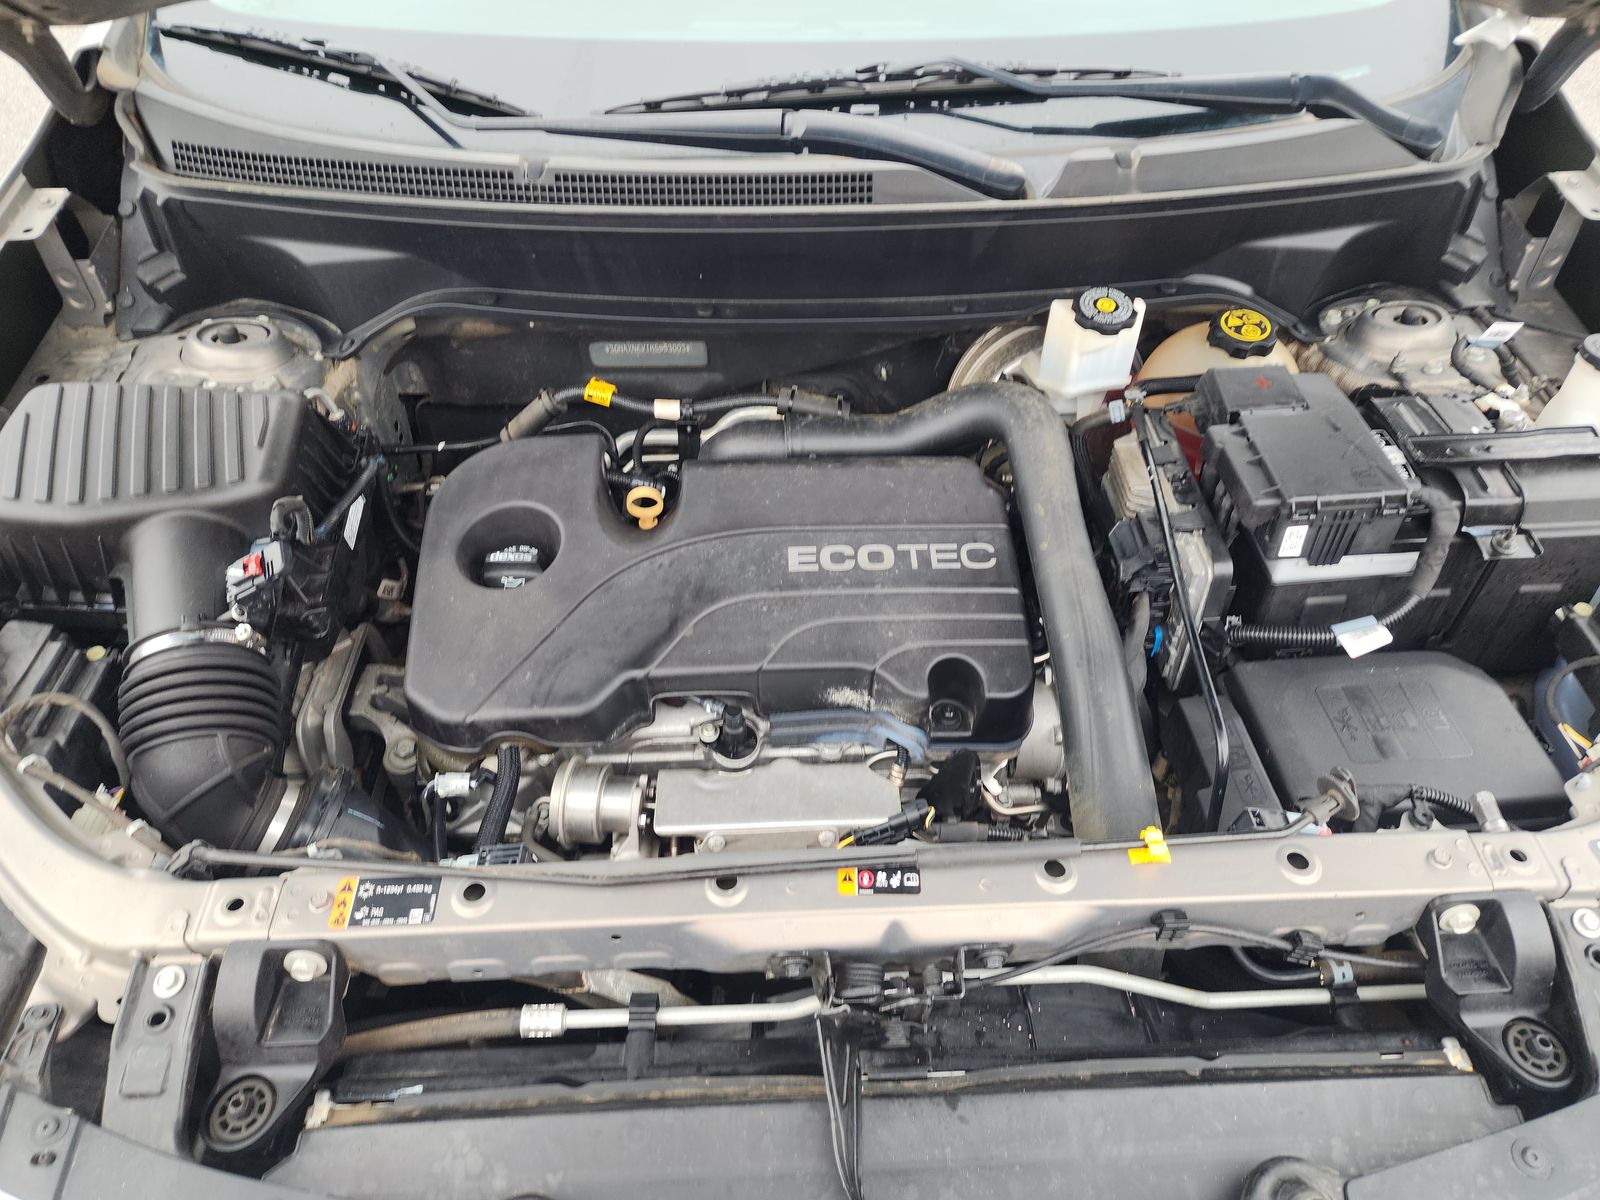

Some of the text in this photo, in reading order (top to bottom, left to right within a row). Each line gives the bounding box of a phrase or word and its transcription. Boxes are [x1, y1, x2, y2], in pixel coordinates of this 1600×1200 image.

[490, 550, 531, 562] dexos
[788, 543, 997, 573] ECOTEC
[424, 883, 433, 894] kg
